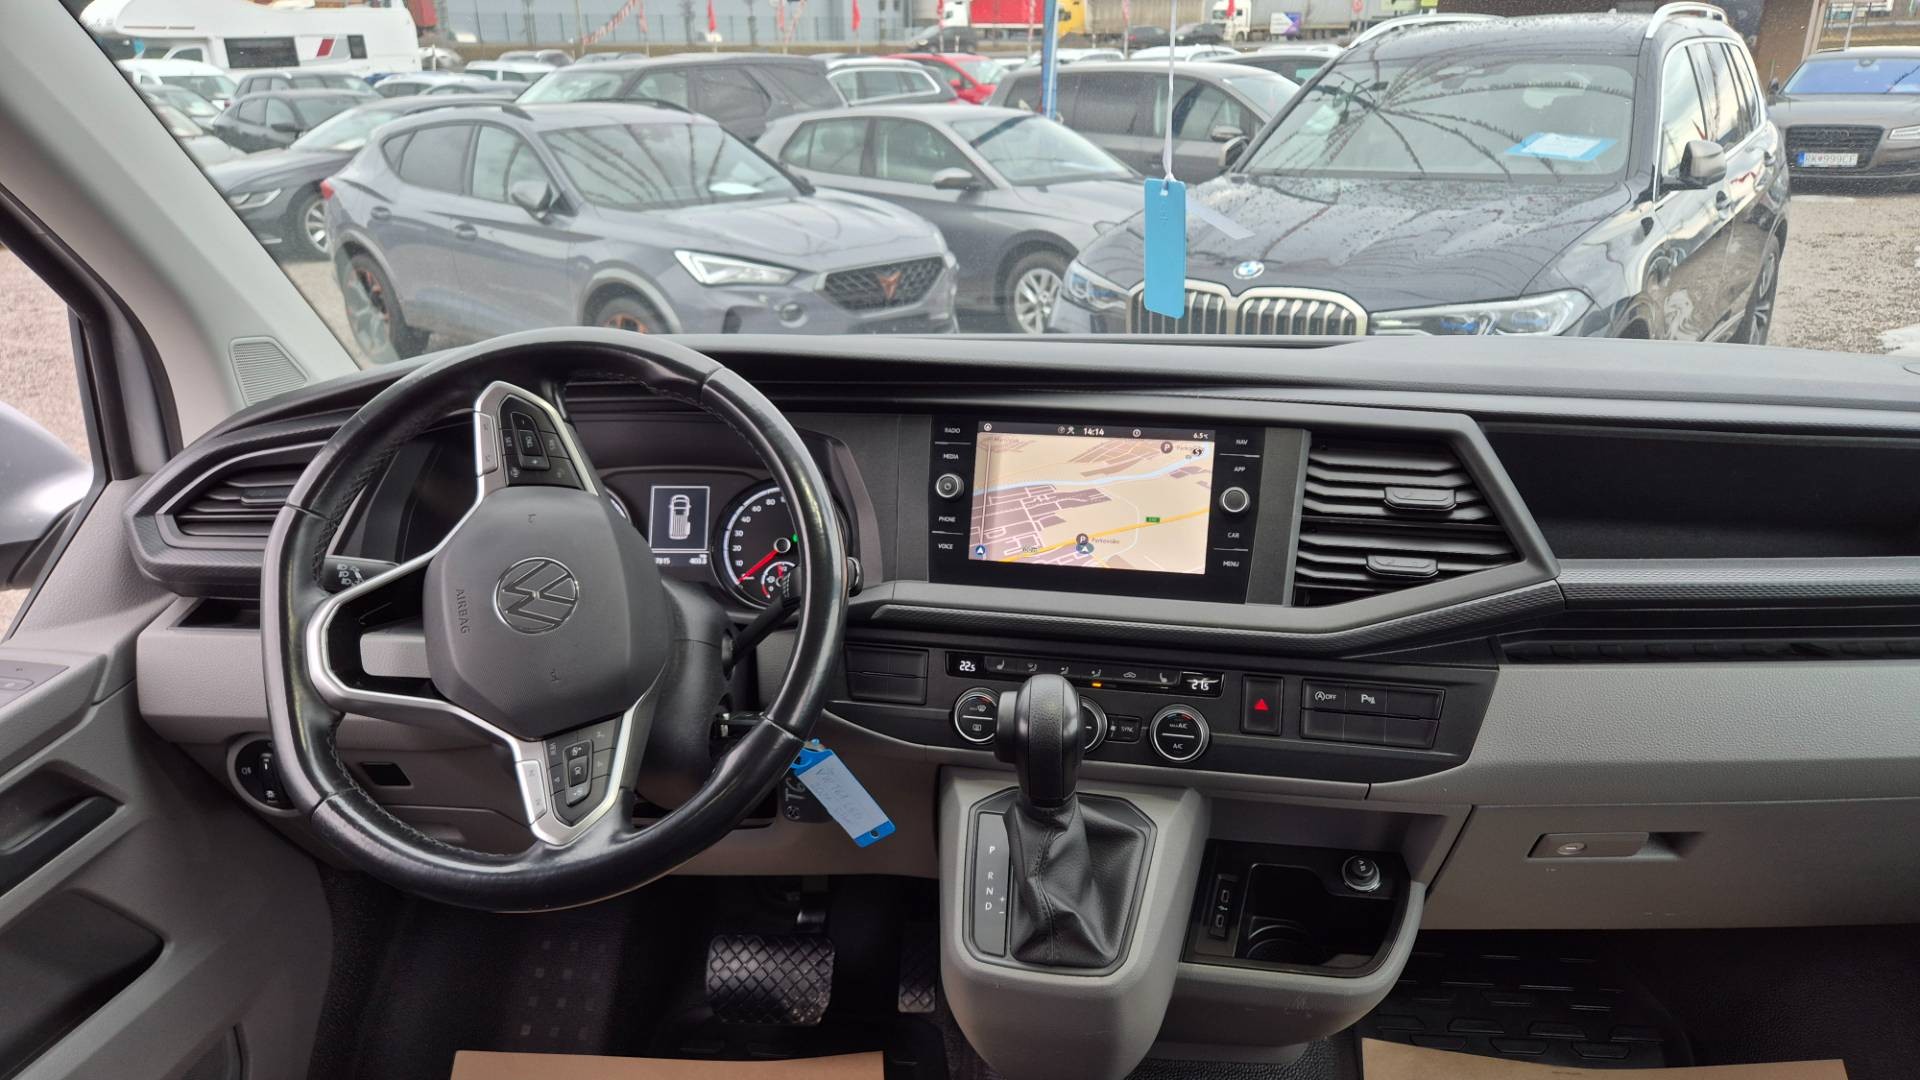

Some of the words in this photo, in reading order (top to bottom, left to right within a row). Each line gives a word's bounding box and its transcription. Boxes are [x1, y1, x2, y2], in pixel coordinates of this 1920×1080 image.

[1083, 427, 1105, 436] 14:14
[732, 544, 742, 552] 20
[1222, 560, 1239, 568] MENU
[456, 588, 471, 634] AIRBAG
[989, 845, 996, 854] P
[988, 871, 994, 880] R
[986, 887, 994, 896] N
[985, 902, 992, 911] D
